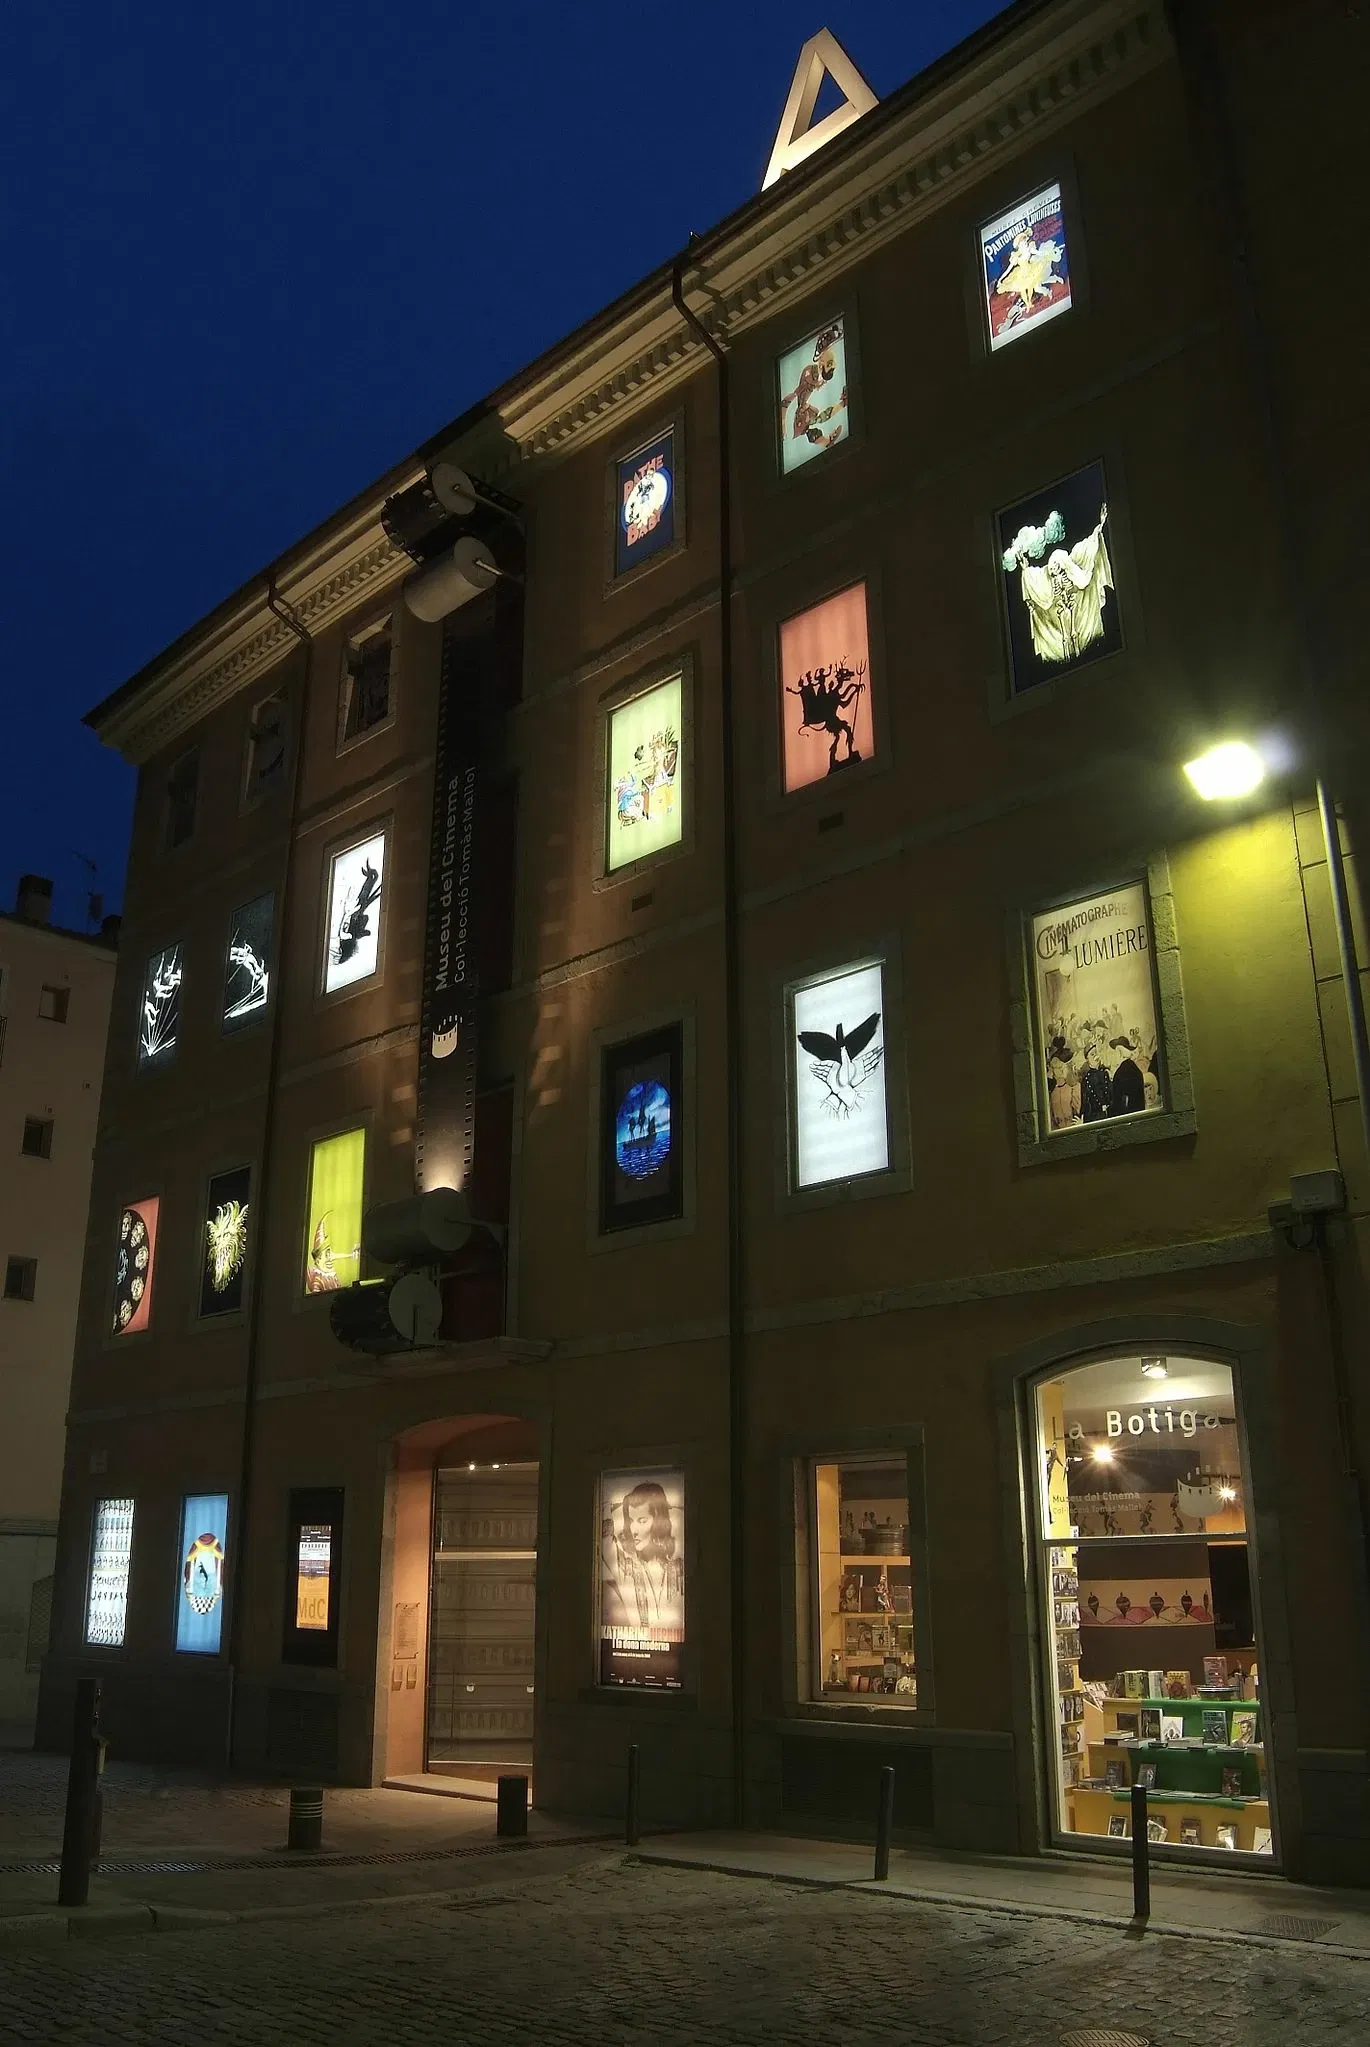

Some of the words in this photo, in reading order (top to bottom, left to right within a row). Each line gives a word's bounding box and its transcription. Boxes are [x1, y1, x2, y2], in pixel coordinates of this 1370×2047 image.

[463, 767, 477, 821] Mallol
[442, 776, 459, 867] Cinema
[439, 872, 453, 907] del
[434, 912, 452, 991] Museu
[1106, 1405, 1224, 1438] Botiga
[1052, 1494, 1082, 1503] Museu
[1085, 1492, 1100, 1501] del
[1102, 1491, 1141, 1501] Cinema
